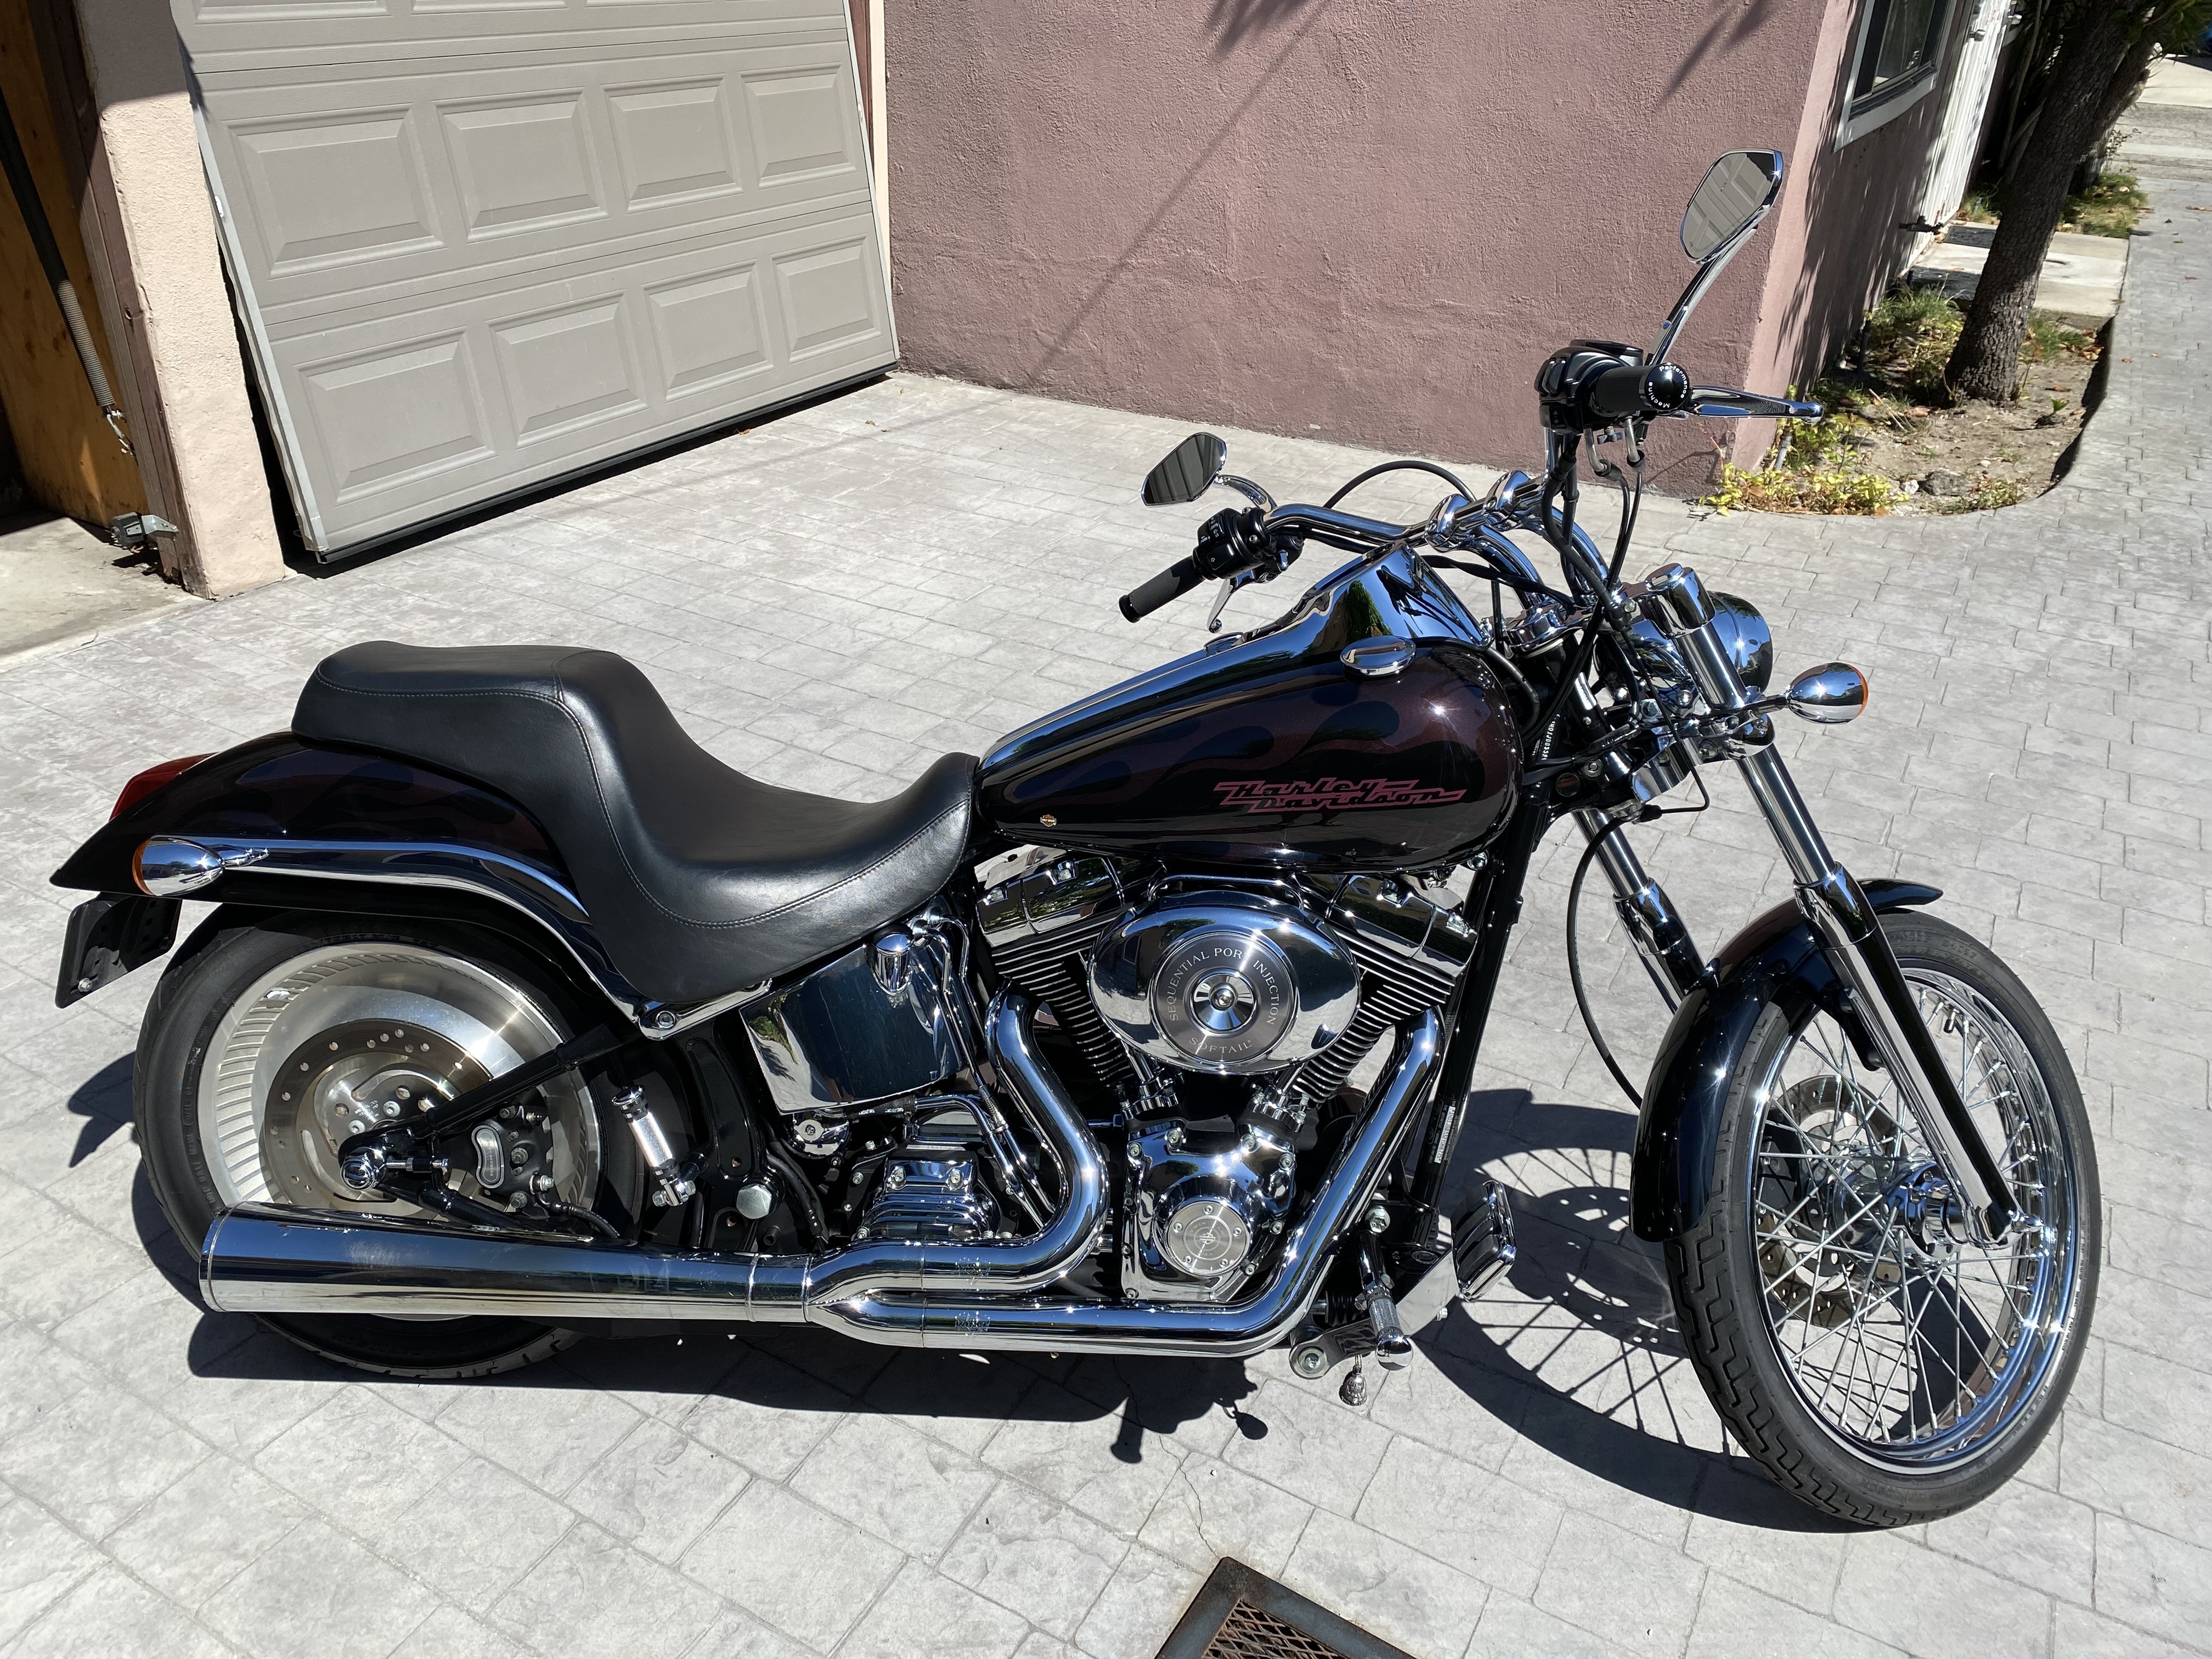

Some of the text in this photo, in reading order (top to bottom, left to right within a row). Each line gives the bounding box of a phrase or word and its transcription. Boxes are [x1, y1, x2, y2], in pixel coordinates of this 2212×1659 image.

[1648, 382, 1671, 408] Machine
[1659, 366, 1688, 399] Performance
[1214, 777, 1420, 803] Harley
[1248, 788, 1468, 813] Davidson
[1166, 947, 1280, 1025] SEQUENTIAL POR INJECTION
